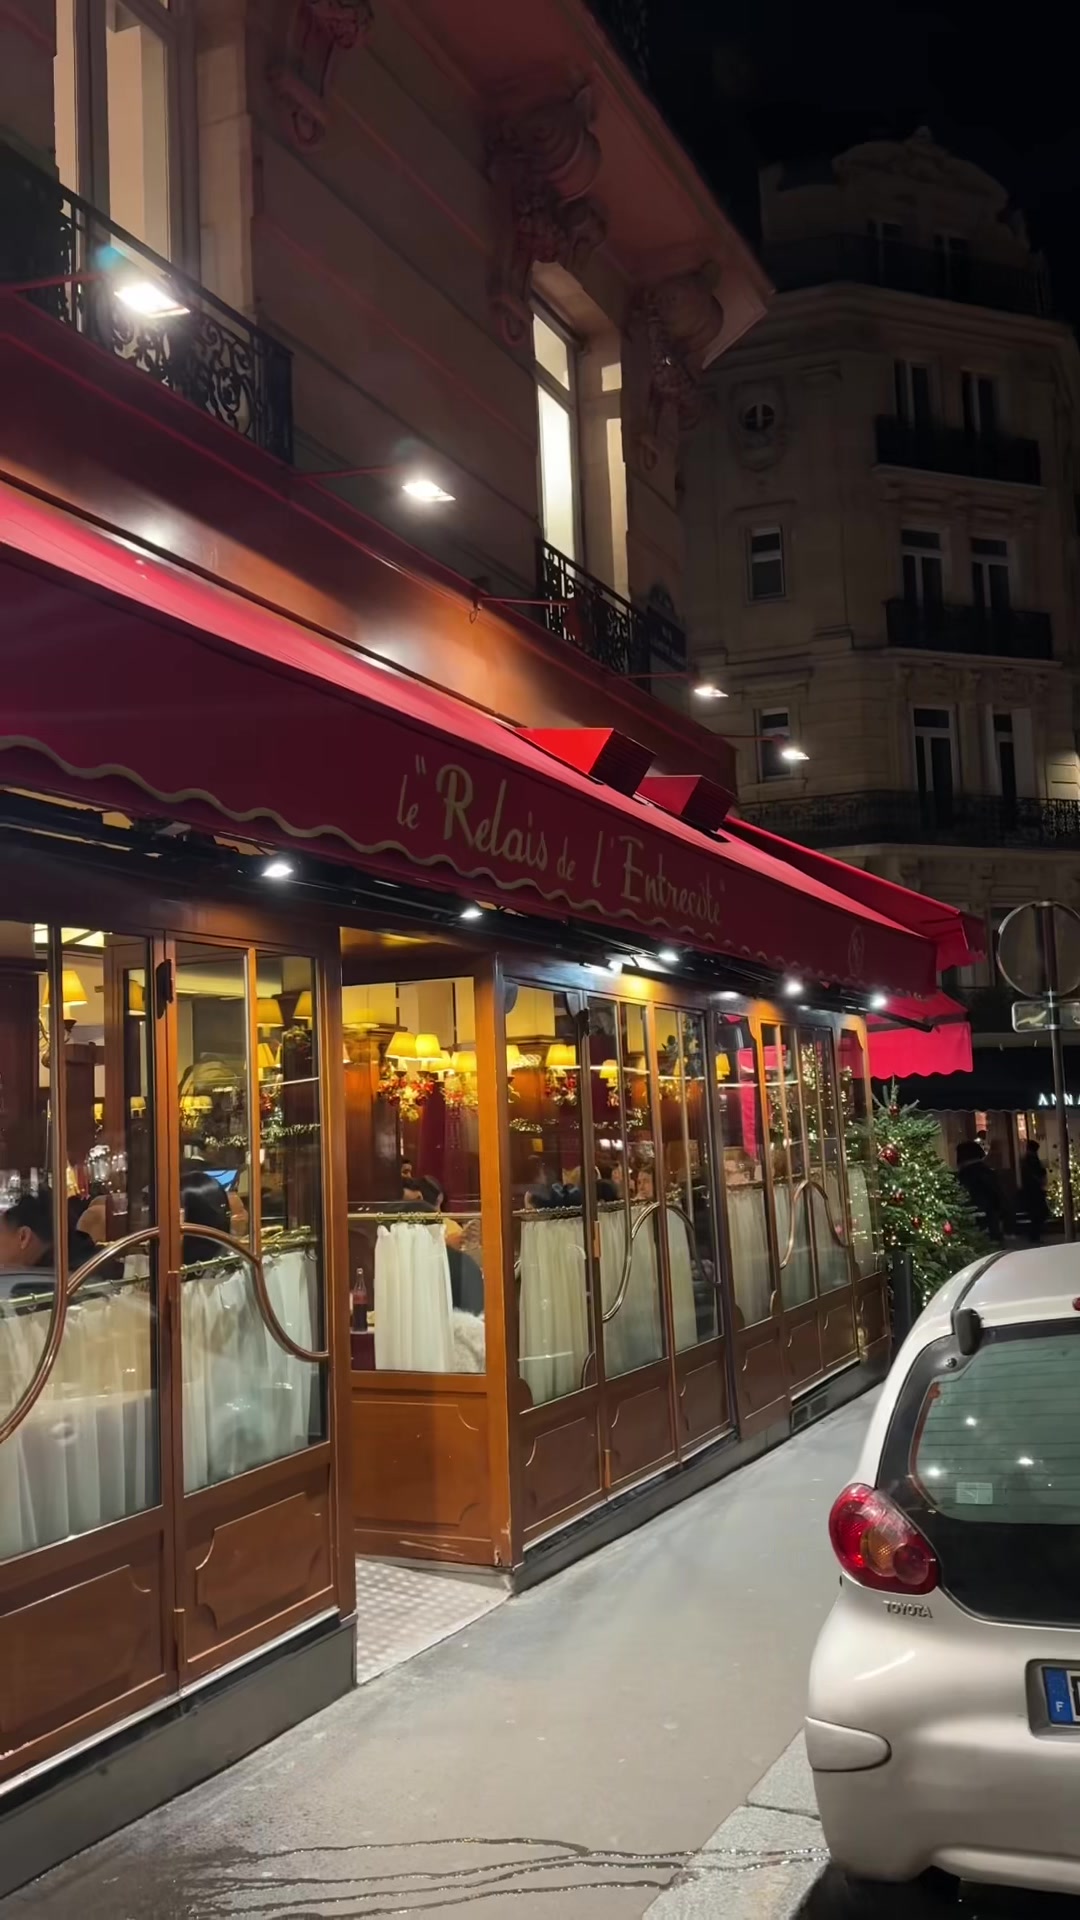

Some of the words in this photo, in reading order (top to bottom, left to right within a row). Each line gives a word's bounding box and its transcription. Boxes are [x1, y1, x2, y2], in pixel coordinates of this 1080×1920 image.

[396, 773, 419, 830] le
[556, 836, 577, 881] de
[882, 1600, 933, 1619] TOYOTA
[1055, 1701, 1065, 1713] F
